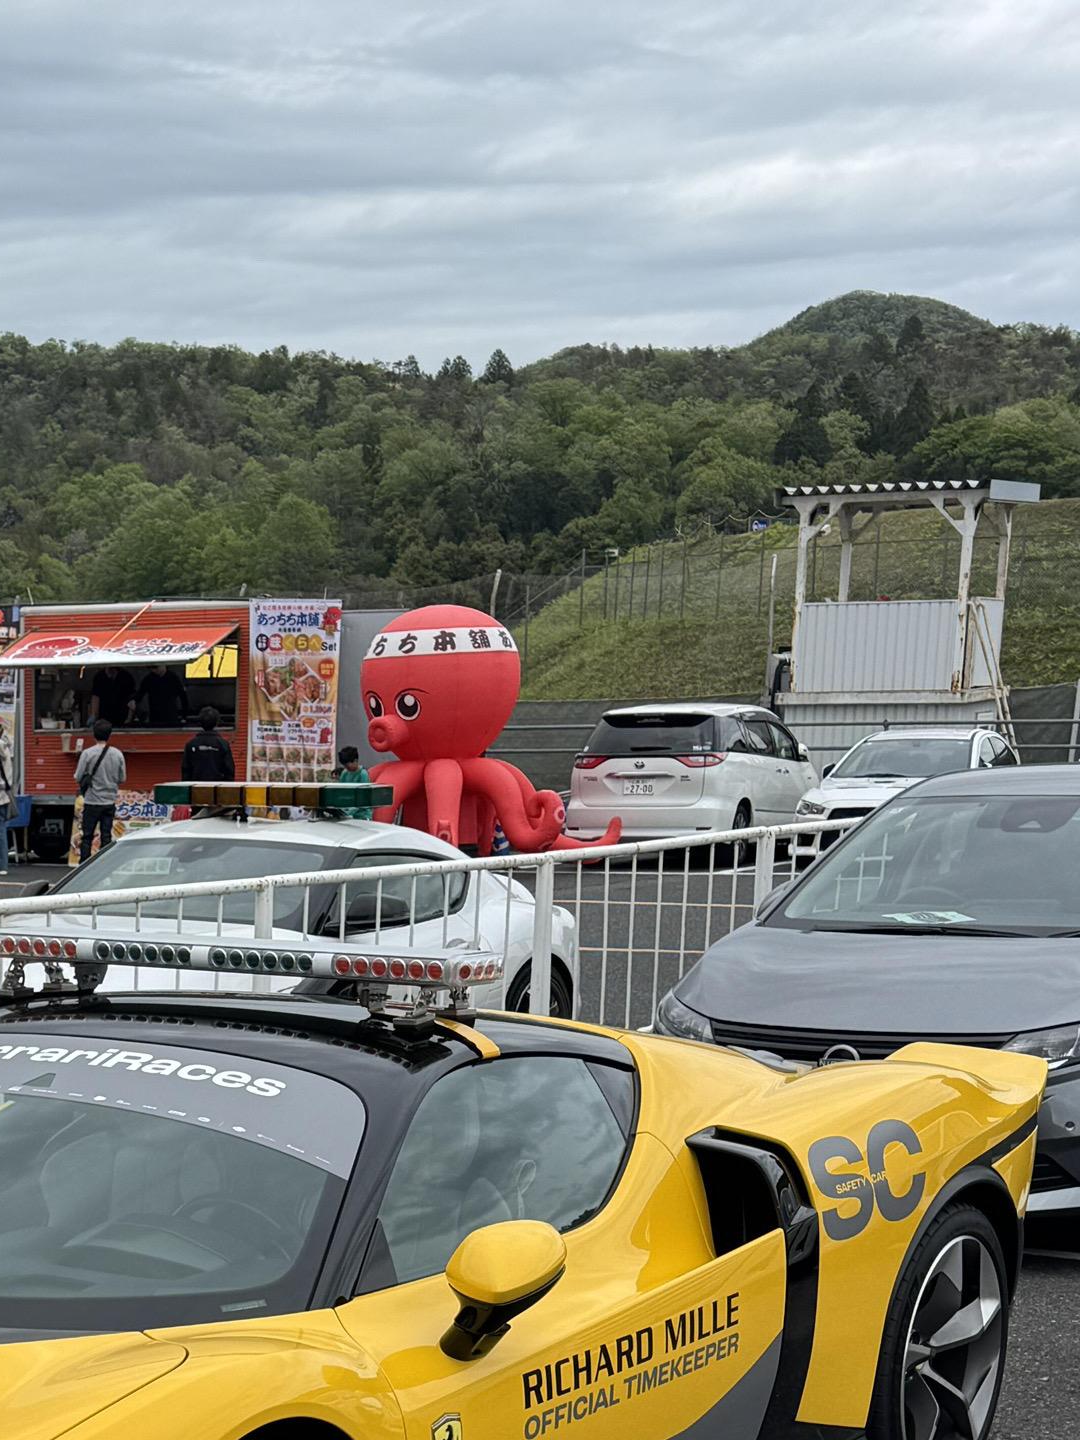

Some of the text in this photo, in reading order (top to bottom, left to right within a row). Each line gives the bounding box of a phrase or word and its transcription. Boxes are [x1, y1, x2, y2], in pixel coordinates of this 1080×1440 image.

[807, 1118, 926, 1241] SC
[835, 1177, 866, 1194] SAFETY
[522, 1292, 739, 1410] RICHARD MILLE
[524, 1332, 740, 1440] OFFICIAL TIMEKEEPER
